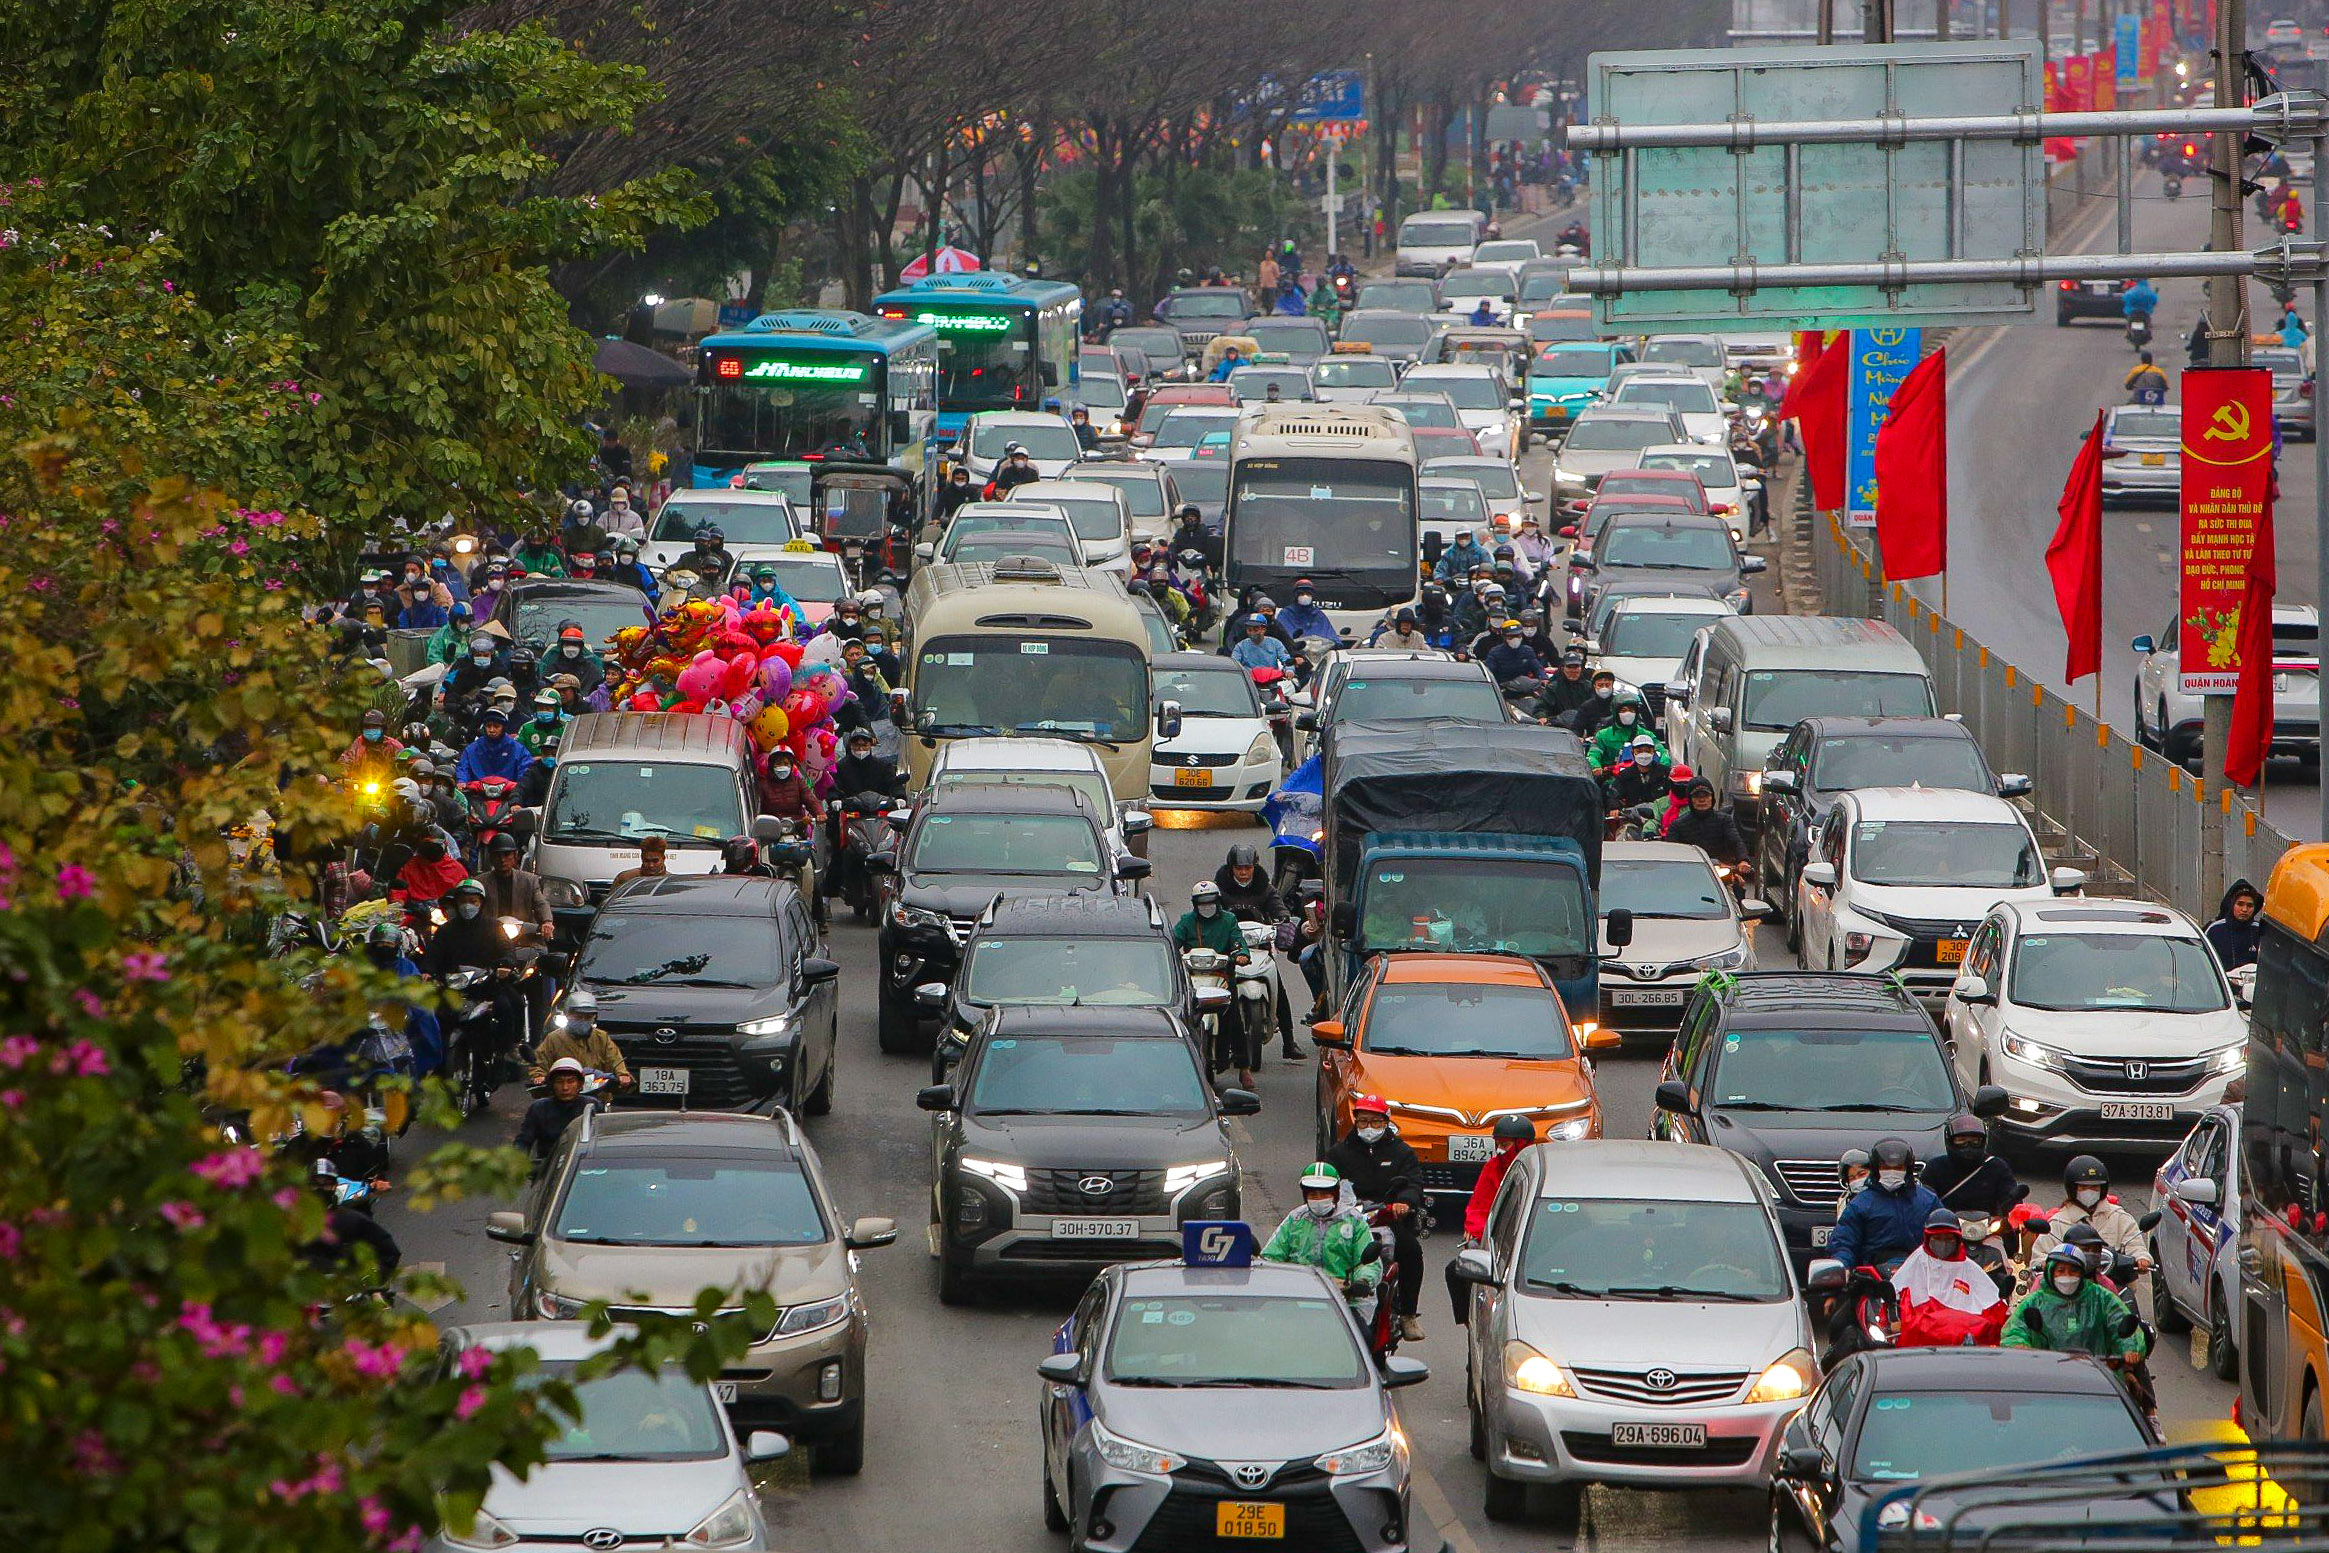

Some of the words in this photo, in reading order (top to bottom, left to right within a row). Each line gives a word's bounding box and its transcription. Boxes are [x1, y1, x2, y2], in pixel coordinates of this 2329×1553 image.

[2226, 519, 2237, 529] THI
[2246, 532, 2255, 547] TẬ
[1285, 549, 1310, 563] 4B
[2213, 549, 2231, 559] THEO
[2184, 676, 2210, 690] QUẬN
[2212, 677, 2239, 688] HOÀN
[1941, 951, 1961, 961] 208
[655, 1070, 675, 1081] 18A
[644, 1081, 686, 1093] 363.75
[2102, 1104, 2171, 1119] 37A-313.81
[1463, 1137, 1486, 1149] 36A
[1453, 1149, 1494, 1161] 894.21
[1059, 1223, 1132, 1236] 30H-970.37
[1200, 1227, 1235, 1262] G7
[1616, 1426, 1703, 1444] 29A-696.04
[1236, 1505, 1266, 1520] 29E
[1224, 1520, 1277, 1536] 018.50
